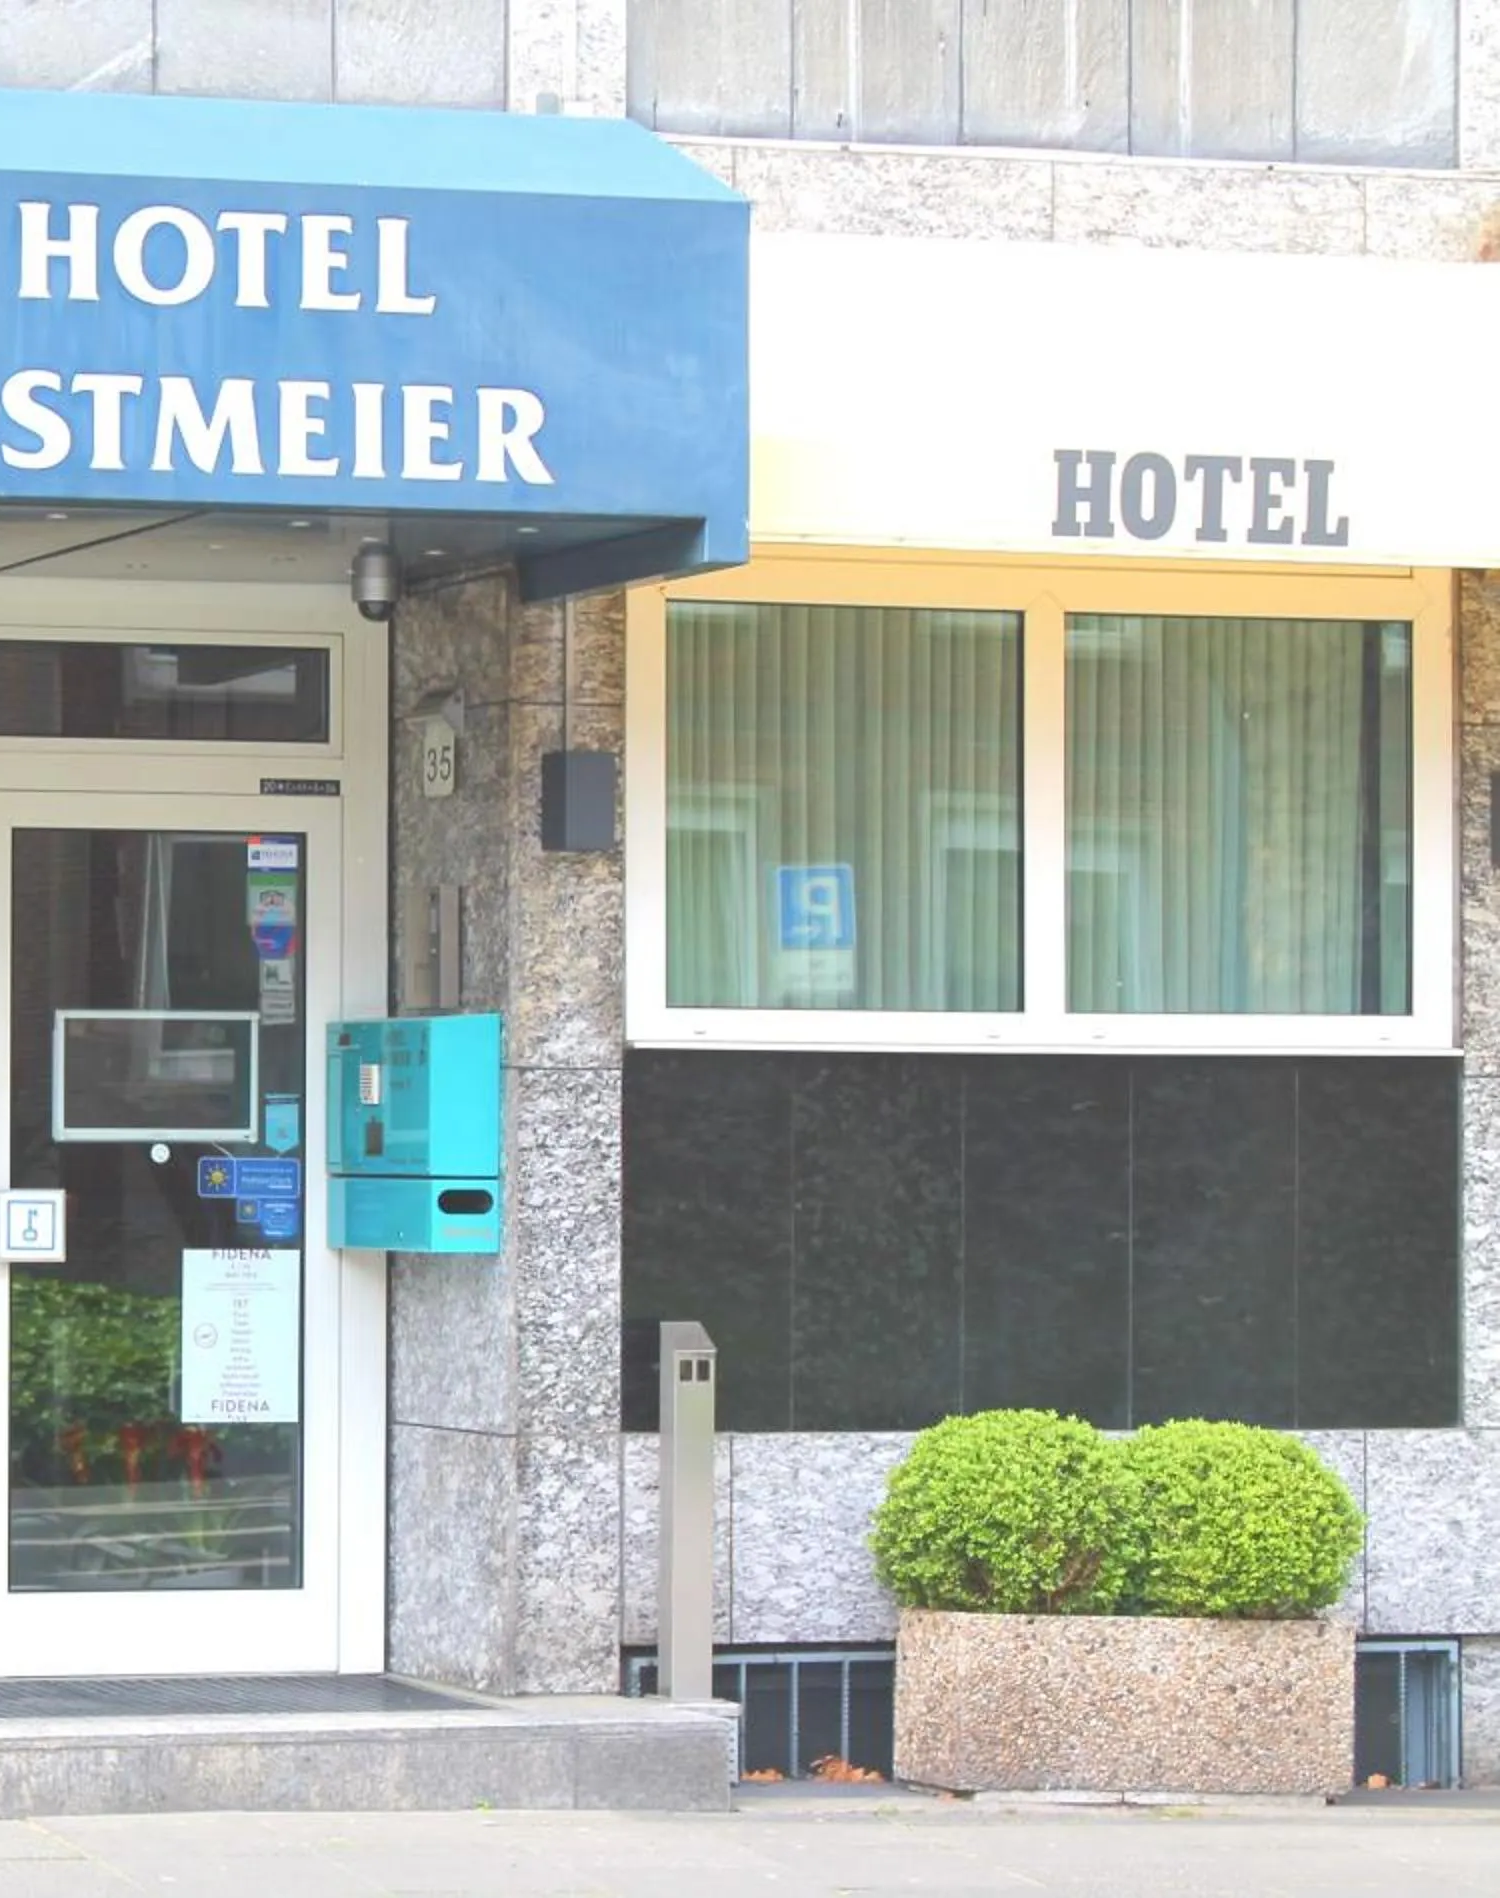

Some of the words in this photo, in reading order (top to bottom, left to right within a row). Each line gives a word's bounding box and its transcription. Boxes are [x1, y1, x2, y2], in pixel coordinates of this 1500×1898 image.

[17, 201, 437, 315] HOTEL
[1051, 449, 1349, 547] HOTEL
[426, 746, 452, 783] 35
[211, 1399, 270, 1413] FIDENA
